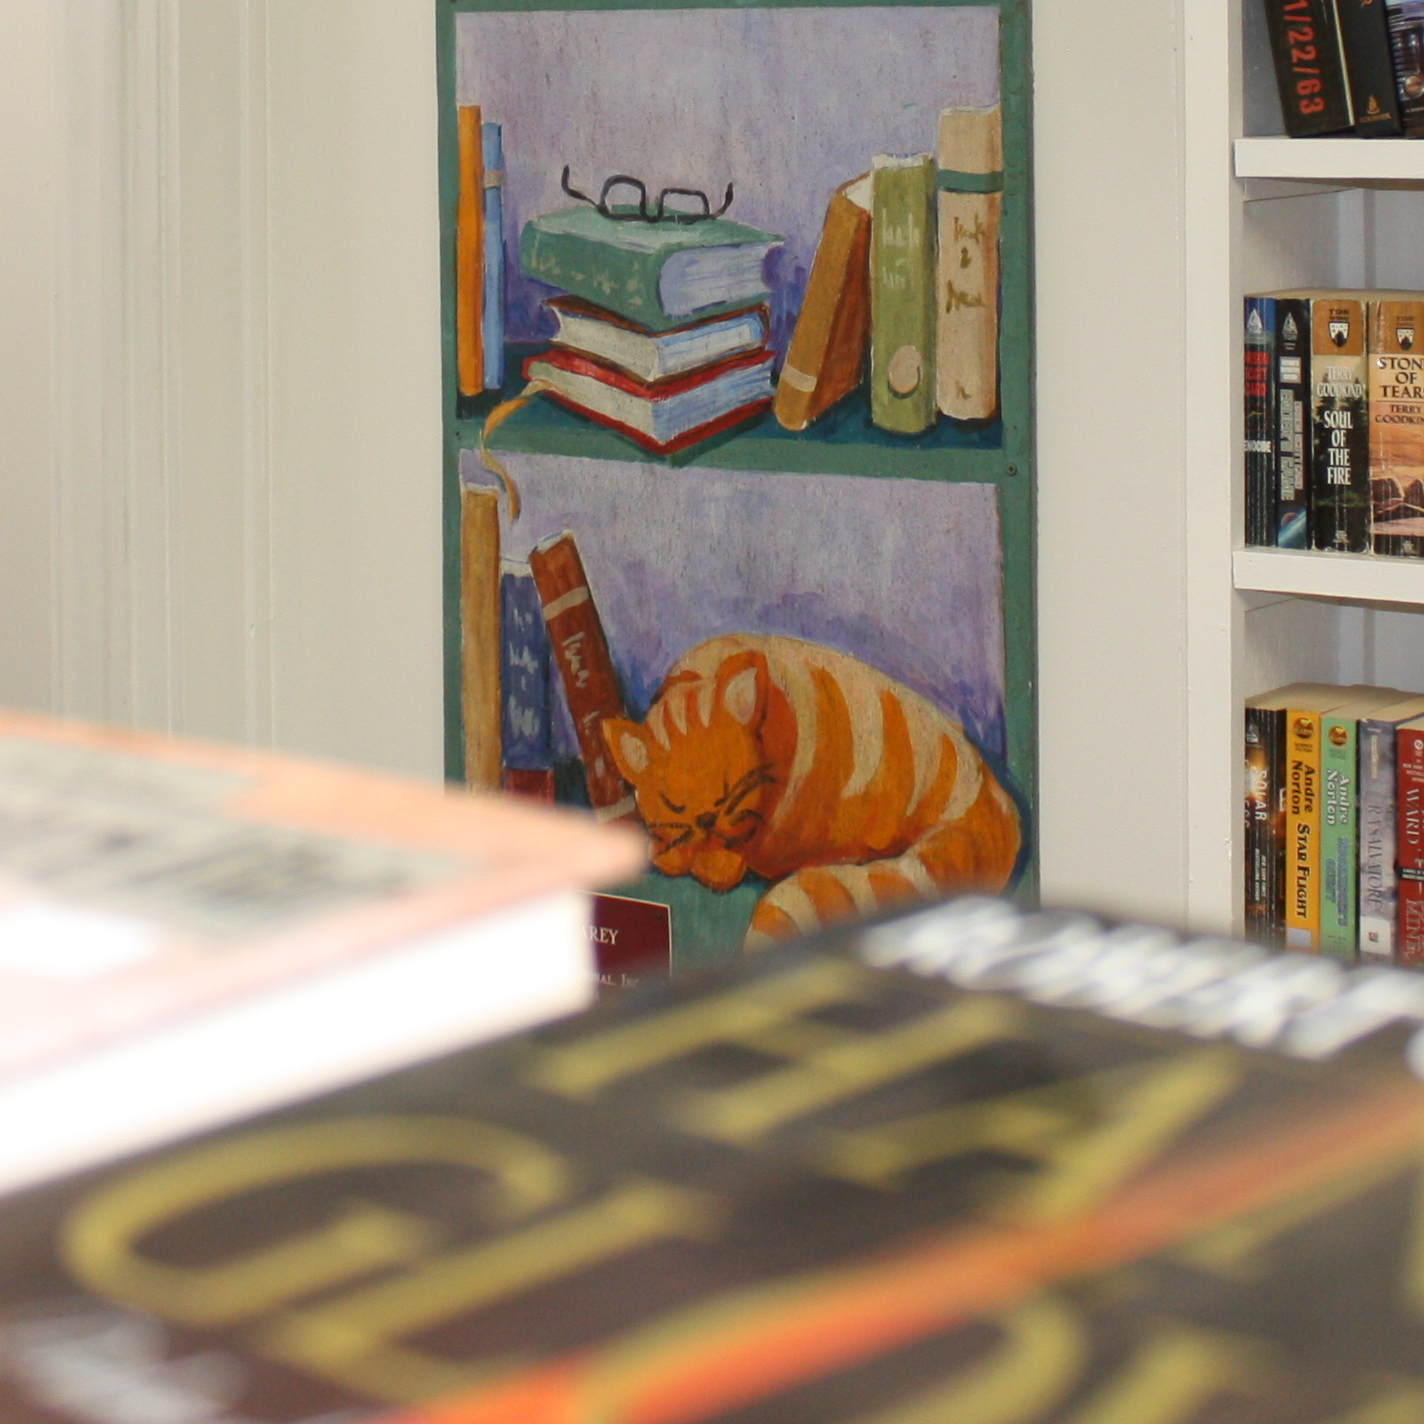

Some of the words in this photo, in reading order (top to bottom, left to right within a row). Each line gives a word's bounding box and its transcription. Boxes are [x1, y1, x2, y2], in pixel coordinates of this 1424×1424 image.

[1395, 372, 1417, 384] OF
[1389, 404, 1421, 414] TERRY
[1323, 410, 1353, 430] SOUL
[1331, 429, 1347, 447] OF
[1328, 448, 1350, 467] THE
[1327, 467, 1351, 485] FIRE
[1291, 759, 1303, 815] Norton
[1304, 764, 1316, 813] Andre
[1296, 822, 1310, 862] STAR
[1296, 865, 1310, 918] FLIGHT
